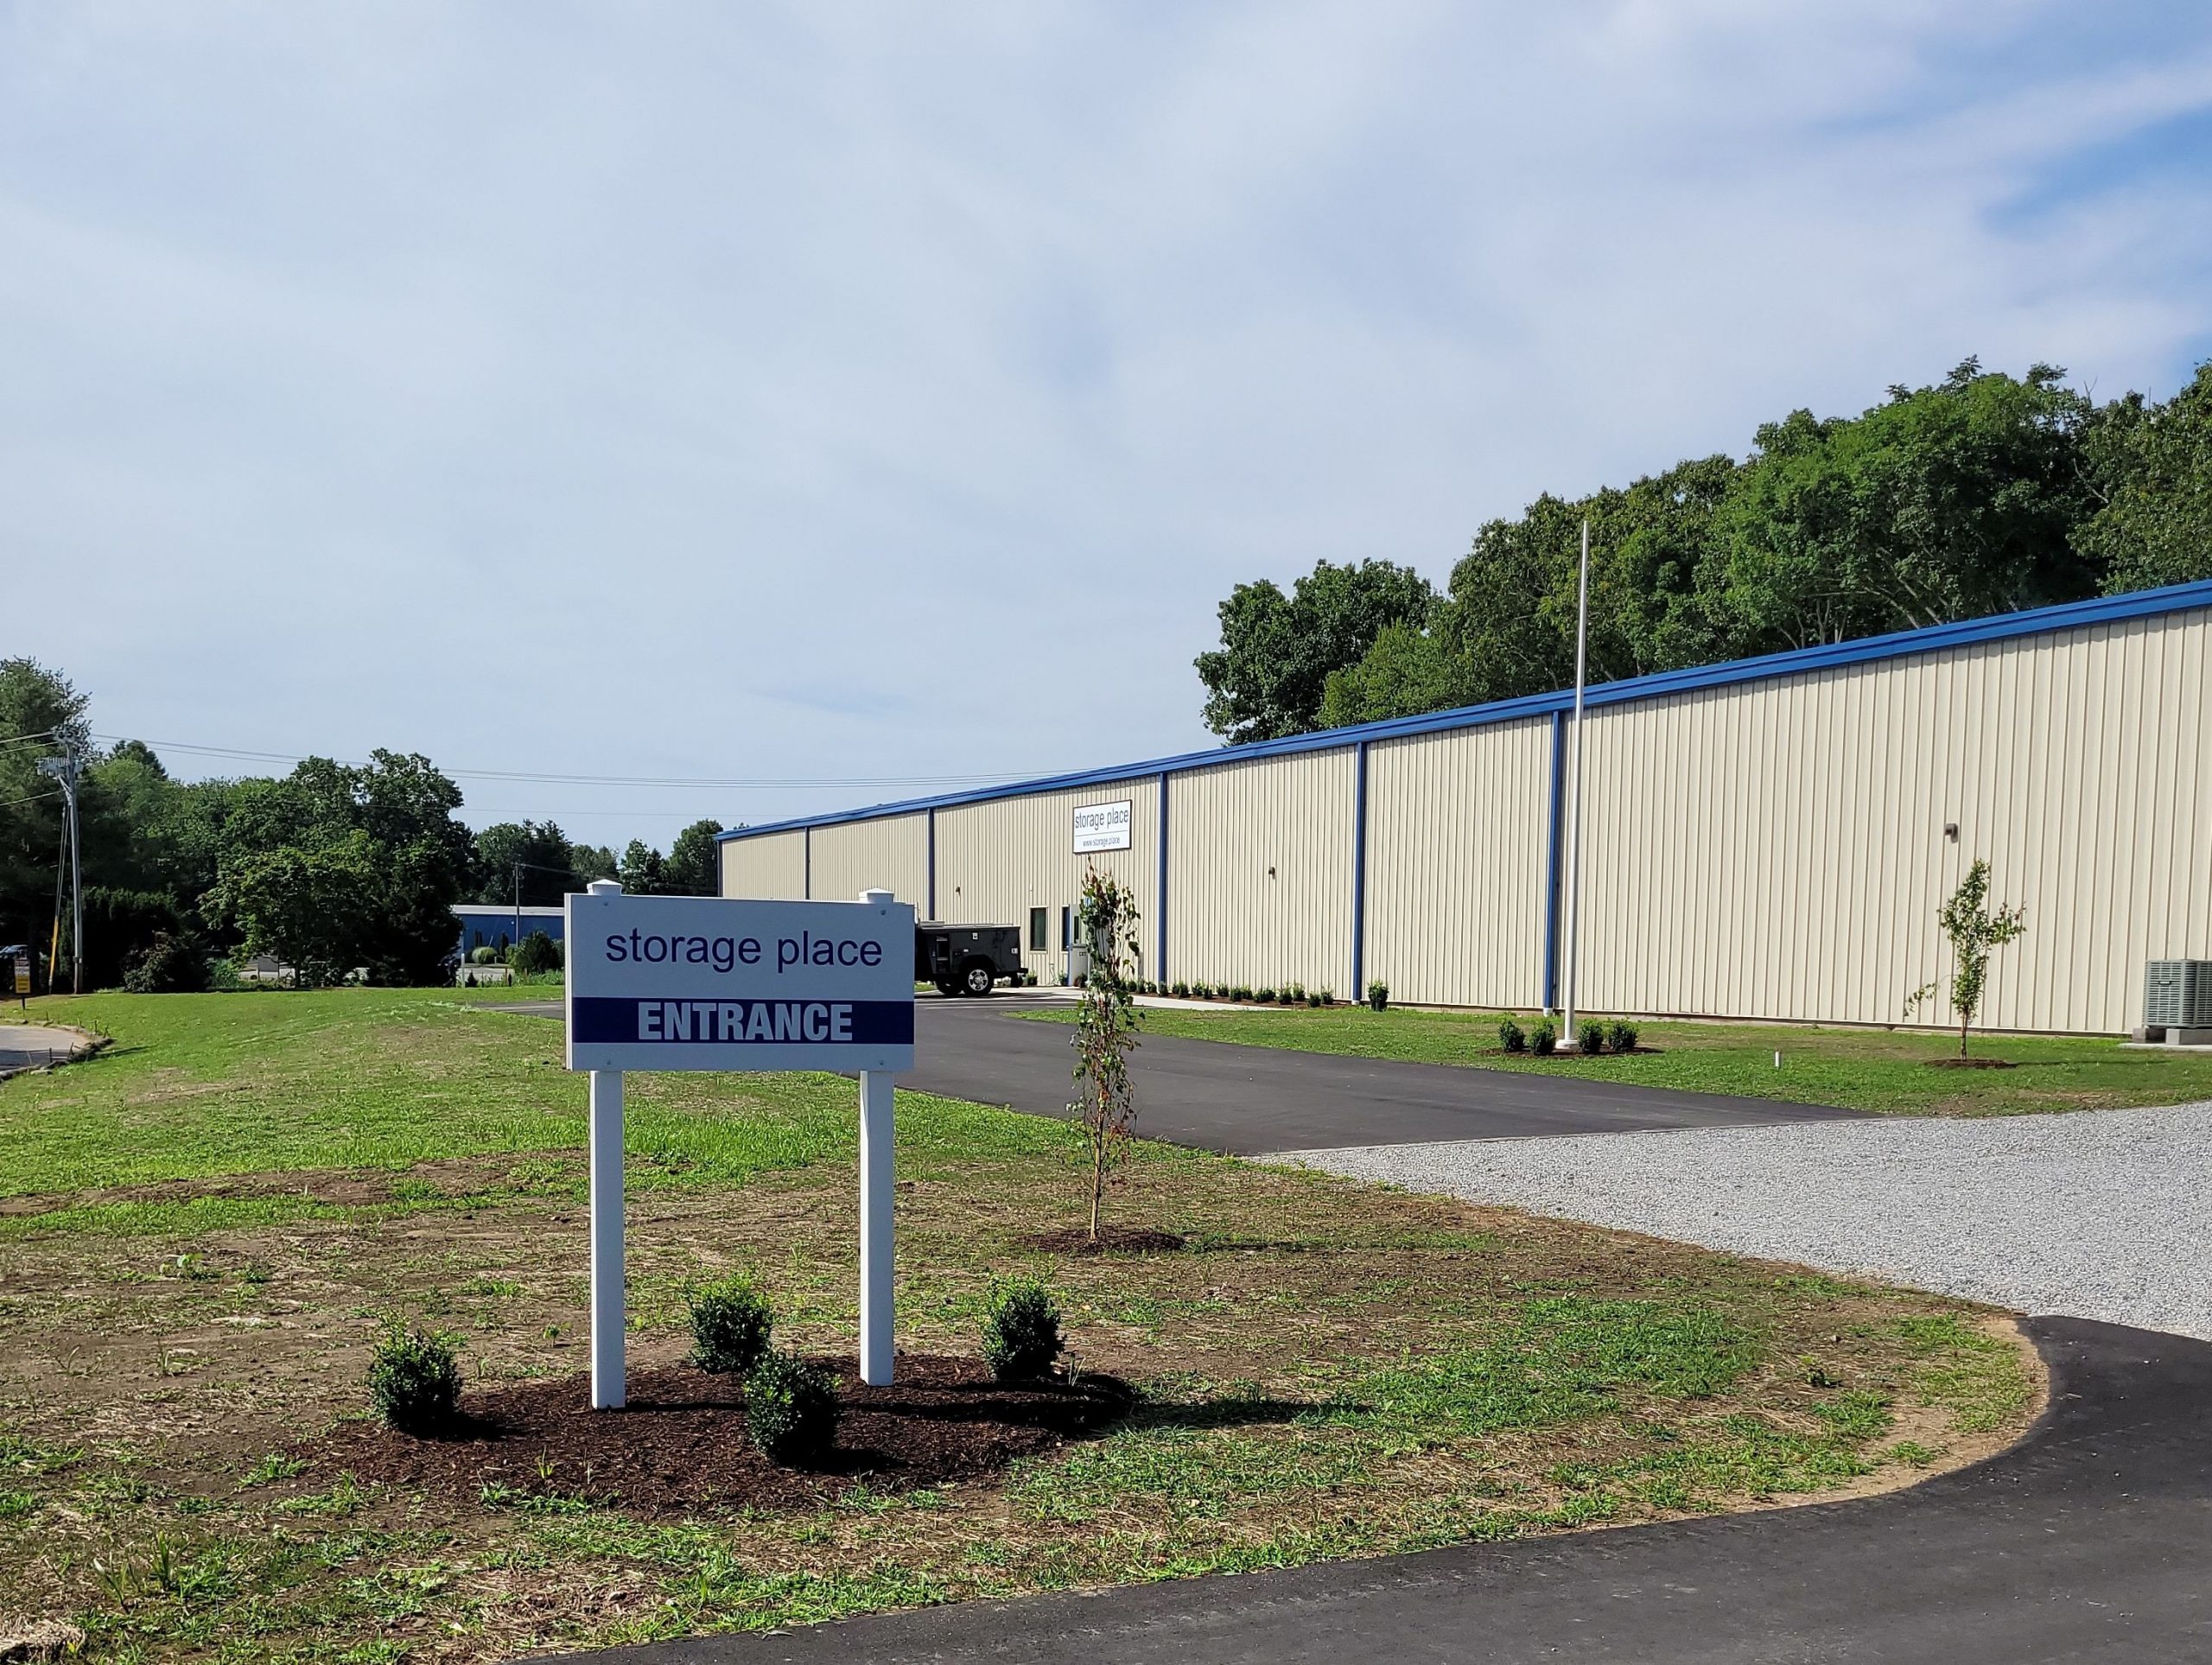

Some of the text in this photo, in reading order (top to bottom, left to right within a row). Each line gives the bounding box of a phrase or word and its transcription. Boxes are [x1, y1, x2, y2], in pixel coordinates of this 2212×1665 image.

[1075, 807, 1128, 830] storage place
[606, 927, 882, 974] storage place
[638, 1001, 853, 1041] ENTRANCE
